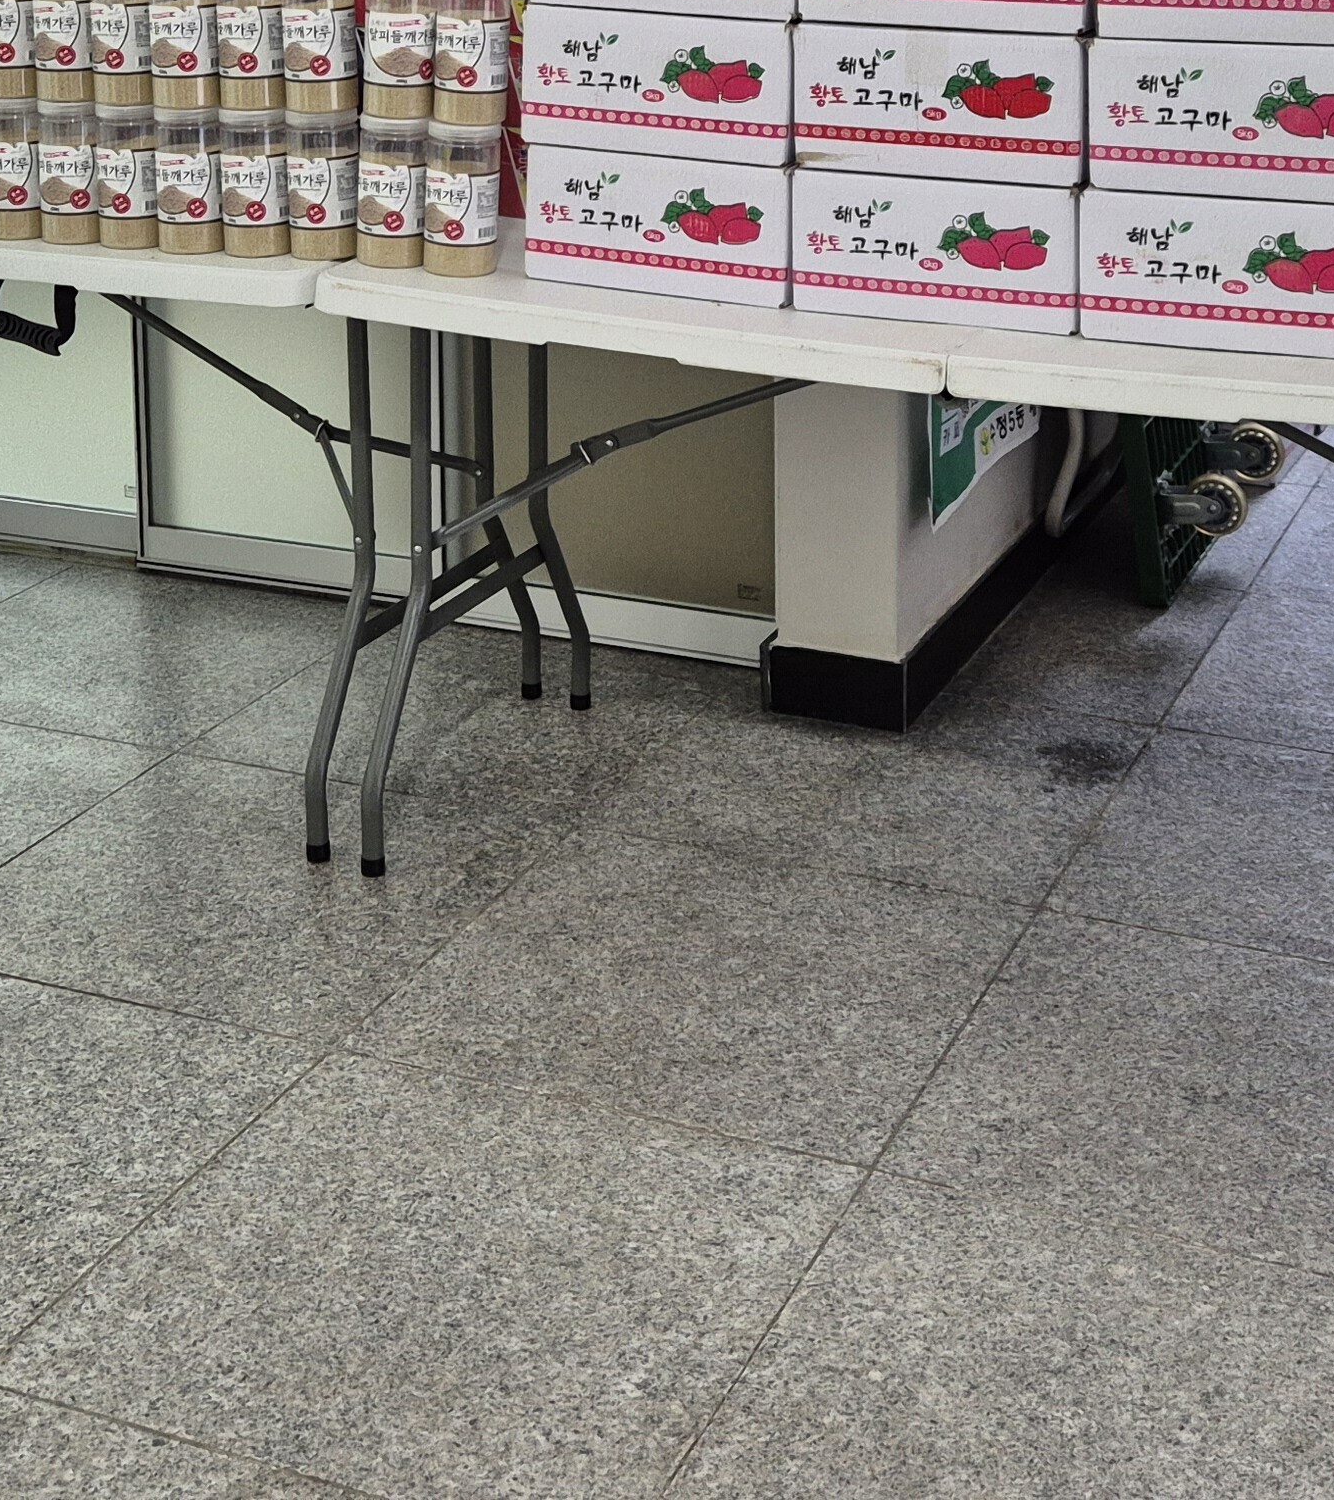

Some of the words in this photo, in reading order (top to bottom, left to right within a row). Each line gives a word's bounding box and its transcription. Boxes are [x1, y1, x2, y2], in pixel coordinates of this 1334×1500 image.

[838, 56, 880, 80] 해남
[810, 83, 848, 106] 황토
[854, 88, 923, 111] 고구마
[834, 204, 875, 229] 해남
[807, 230, 845, 254] 황토
[850, 236, 919, 260] 고구마
